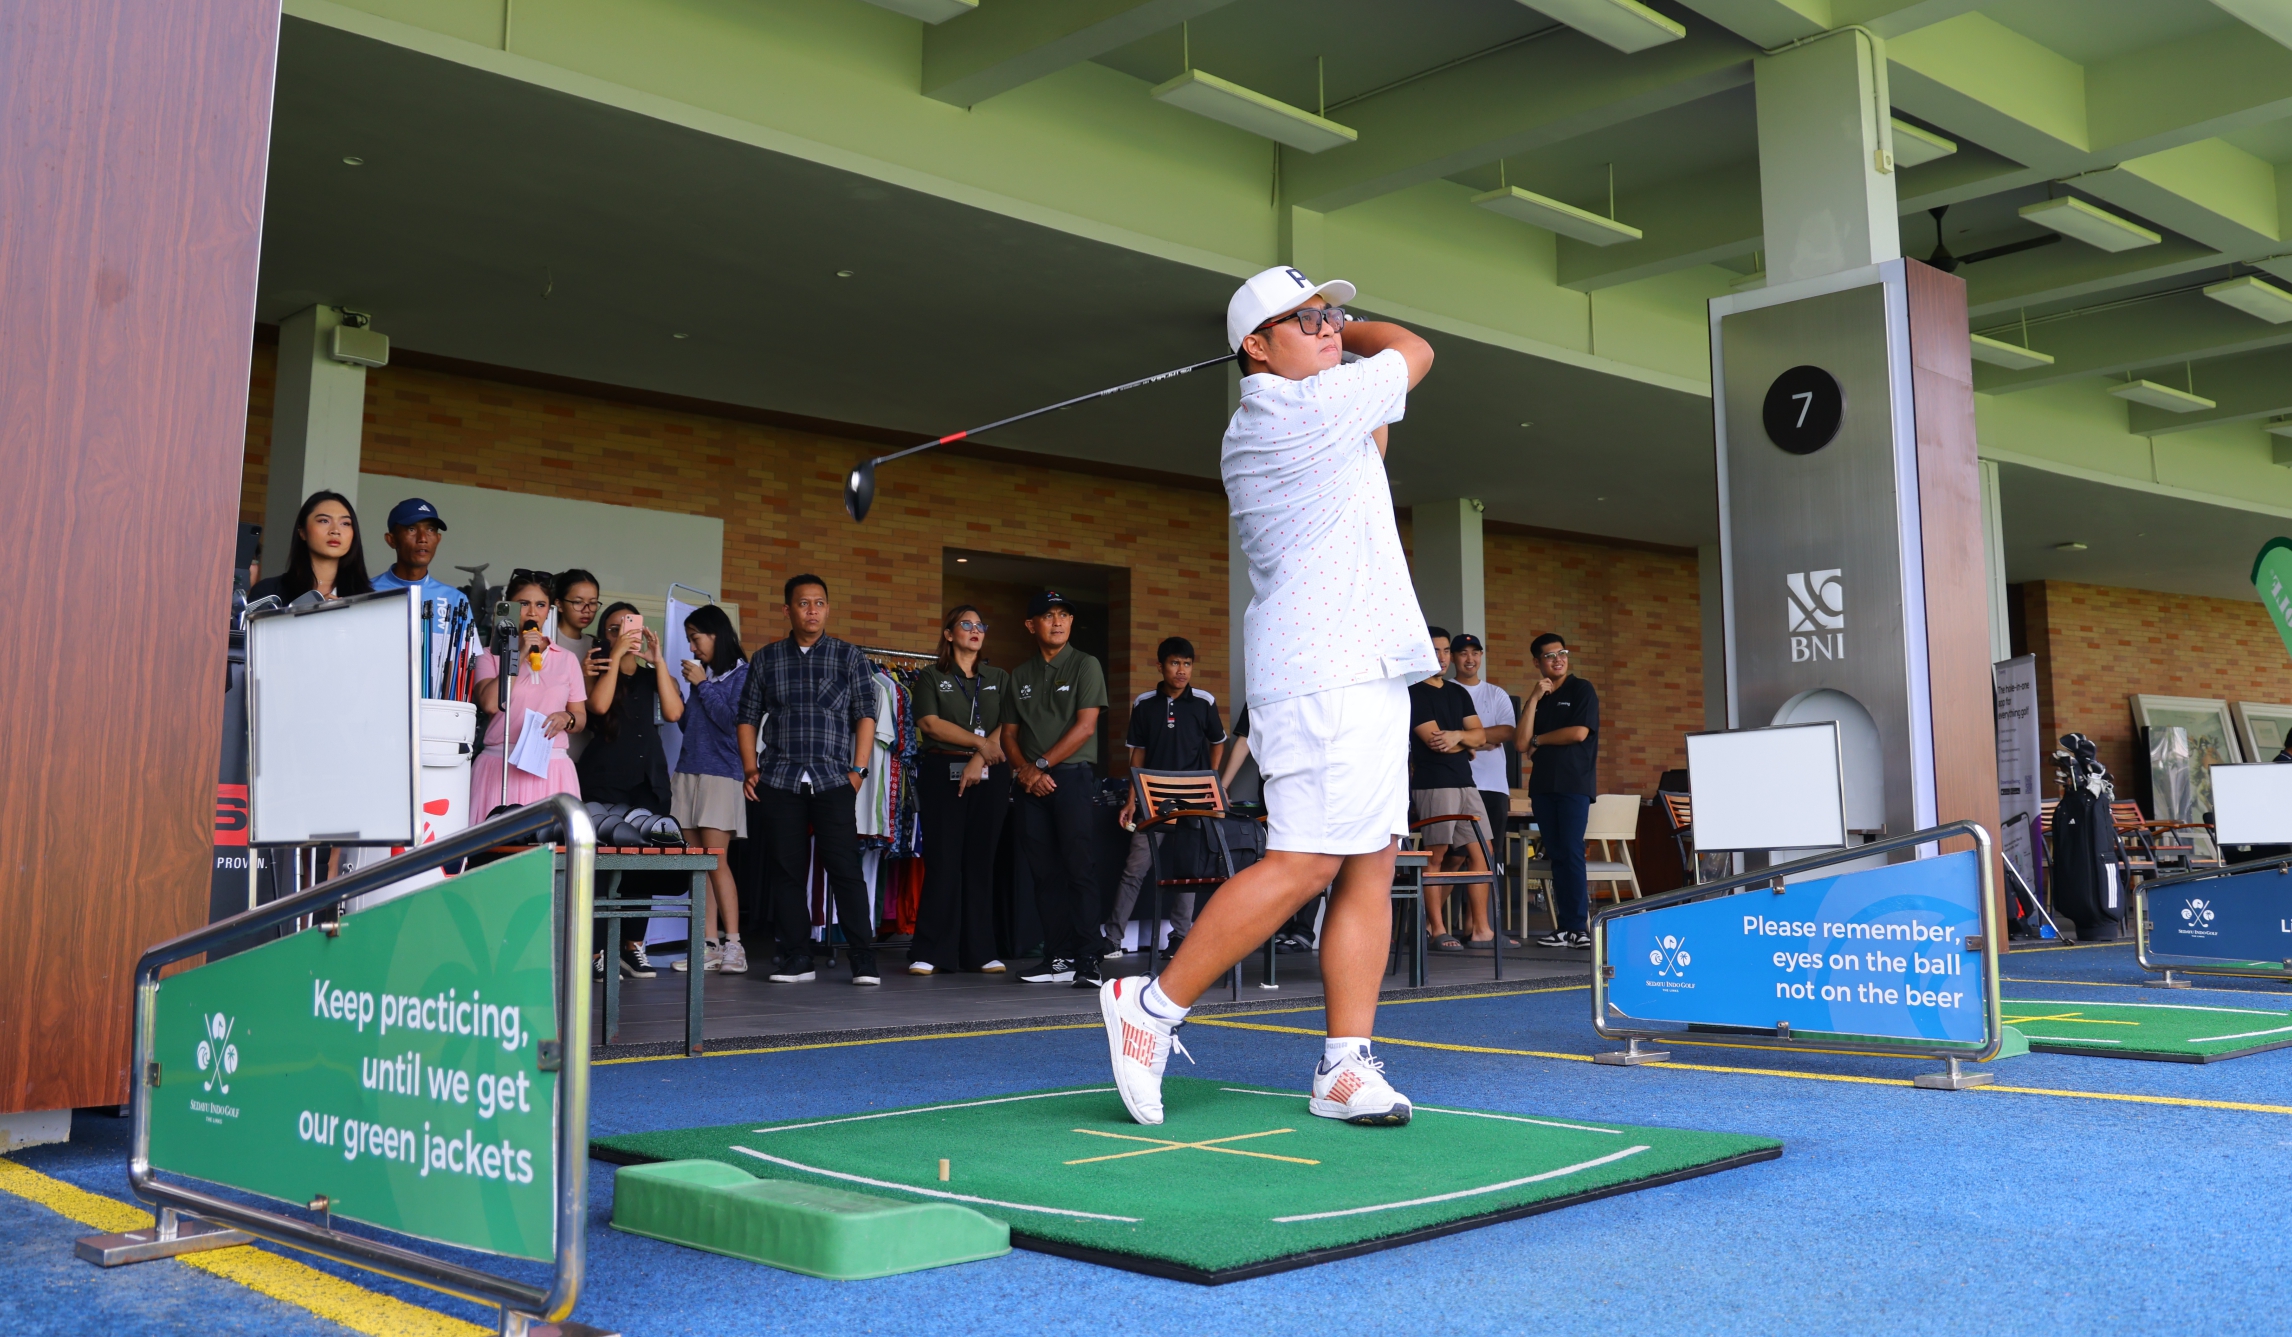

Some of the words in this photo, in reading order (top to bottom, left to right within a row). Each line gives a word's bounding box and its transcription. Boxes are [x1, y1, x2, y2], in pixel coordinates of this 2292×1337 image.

[1285, 268, 1307, 289] P
[1791, 391, 1813, 428] 7
[437, 597, 449, 630] new
[1790, 632, 1844, 663] BNI
[217, 857, 268, 869] PROVN.
[1743, 916, 1816, 937] Please
[1823, 920, 1960, 945] remember,
[1773, 951, 1823, 972] eyes
[1829, 954, 1859, 970] on
[1866, 951, 1907, 972] the
[1914, 952, 1961, 975] ball
[1776, 981, 1815, 999] not
[1821, 985, 1851, 1002] on
[1857, 982, 1898, 1004] the
[1905, 984, 1963, 1008] beer
[314, 979, 374, 1032] Keep
[381, 988, 528, 1051] practicing,
[362, 1051, 420, 1096] until
[427, 1066, 469, 1103] we
[477, 1070, 530, 1119] get
[190, 1099, 210, 1112] SEDAYU
[299, 1110, 339, 1146] our
[344, 1119, 415, 1163] green
[420, 1121, 533, 1183] jackets
